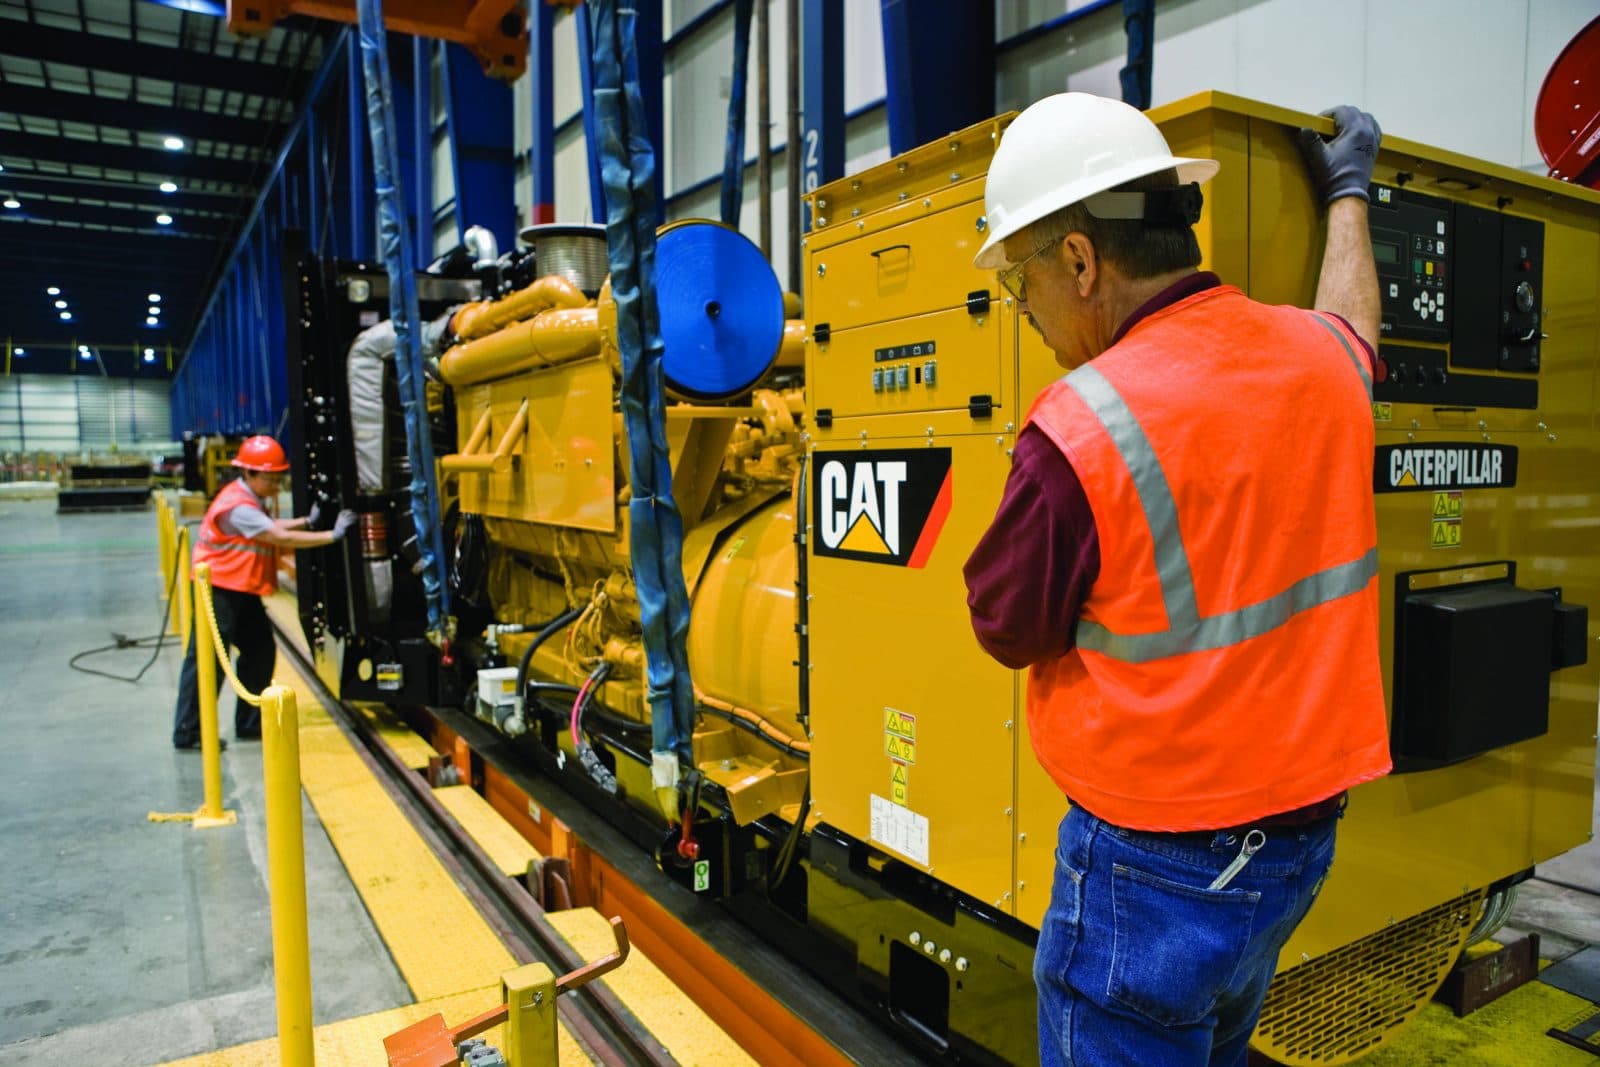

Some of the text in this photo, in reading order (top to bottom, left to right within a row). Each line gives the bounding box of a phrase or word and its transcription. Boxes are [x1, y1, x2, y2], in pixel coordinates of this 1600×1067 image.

[1378, 187, 1392, 203] CAT
[1390, 449, 1503, 486] CATERPILLAR
[821, 460, 907, 555] CAT
